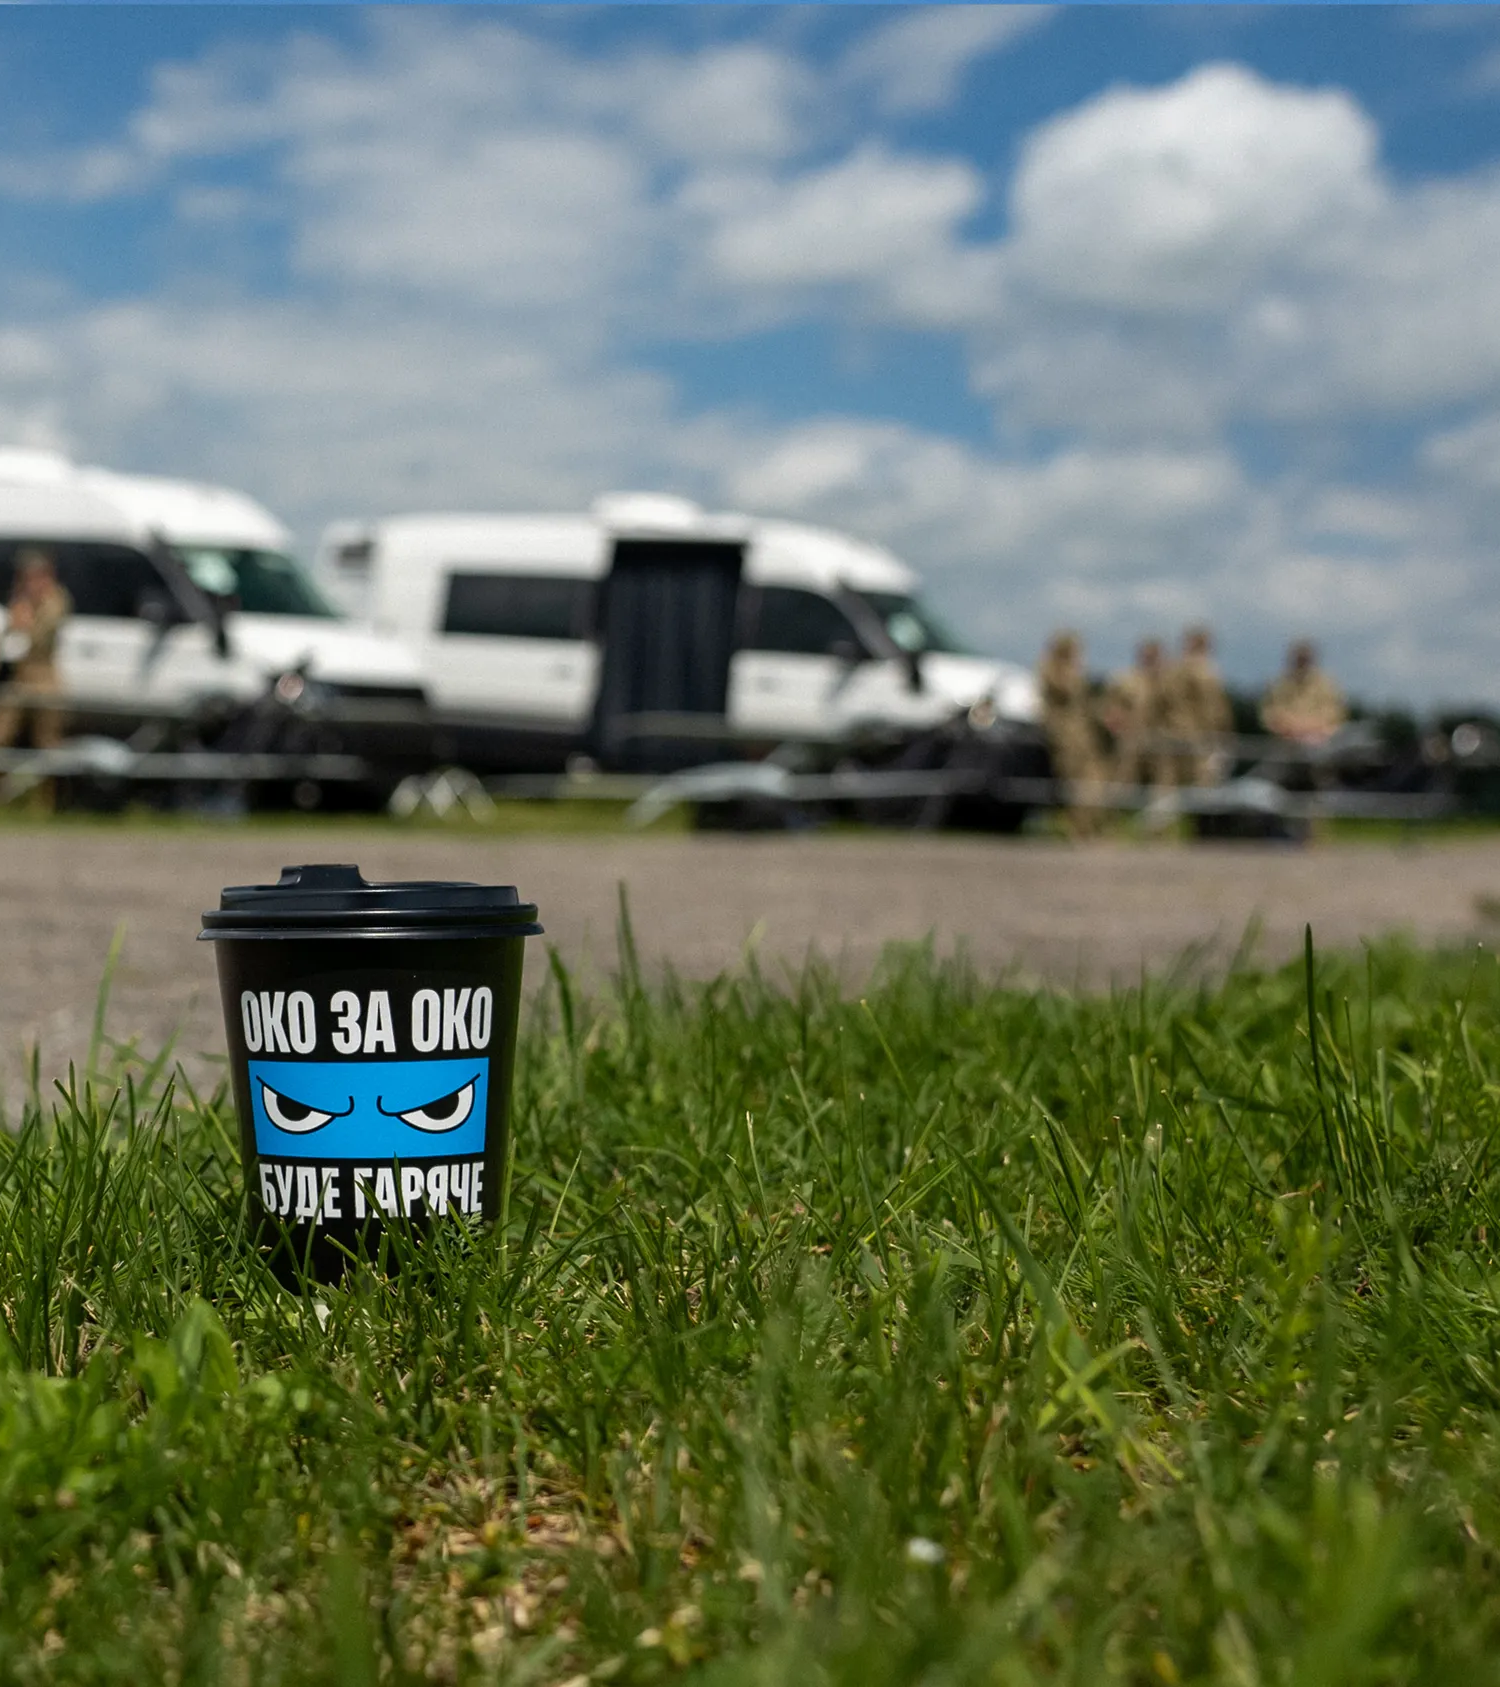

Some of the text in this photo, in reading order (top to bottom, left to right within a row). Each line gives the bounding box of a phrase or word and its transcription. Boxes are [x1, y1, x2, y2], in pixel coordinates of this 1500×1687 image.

[241, 986, 493, 1054] ОКО ЗА ОКО
[258, 1161, 485, 1226] БУДЕ ГАРЯЧЕ
